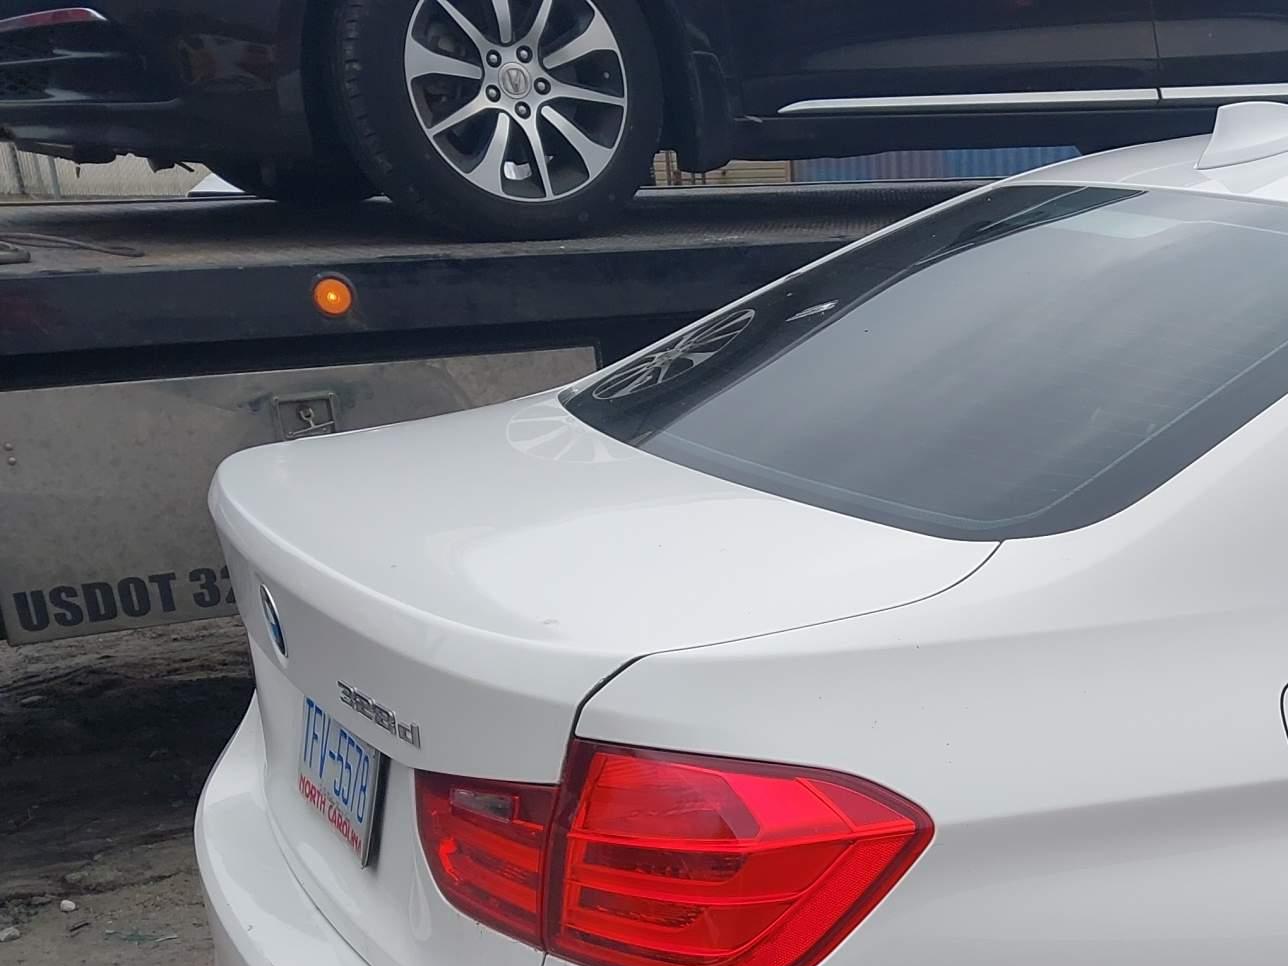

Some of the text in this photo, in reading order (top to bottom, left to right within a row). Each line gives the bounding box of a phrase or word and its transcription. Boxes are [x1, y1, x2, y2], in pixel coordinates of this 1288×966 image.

[12, 572, 176, 632] USDOT
[303, 697, 369, 824] TFV-5578
[299, 774, 362, 852] NORTH CAROLINA
